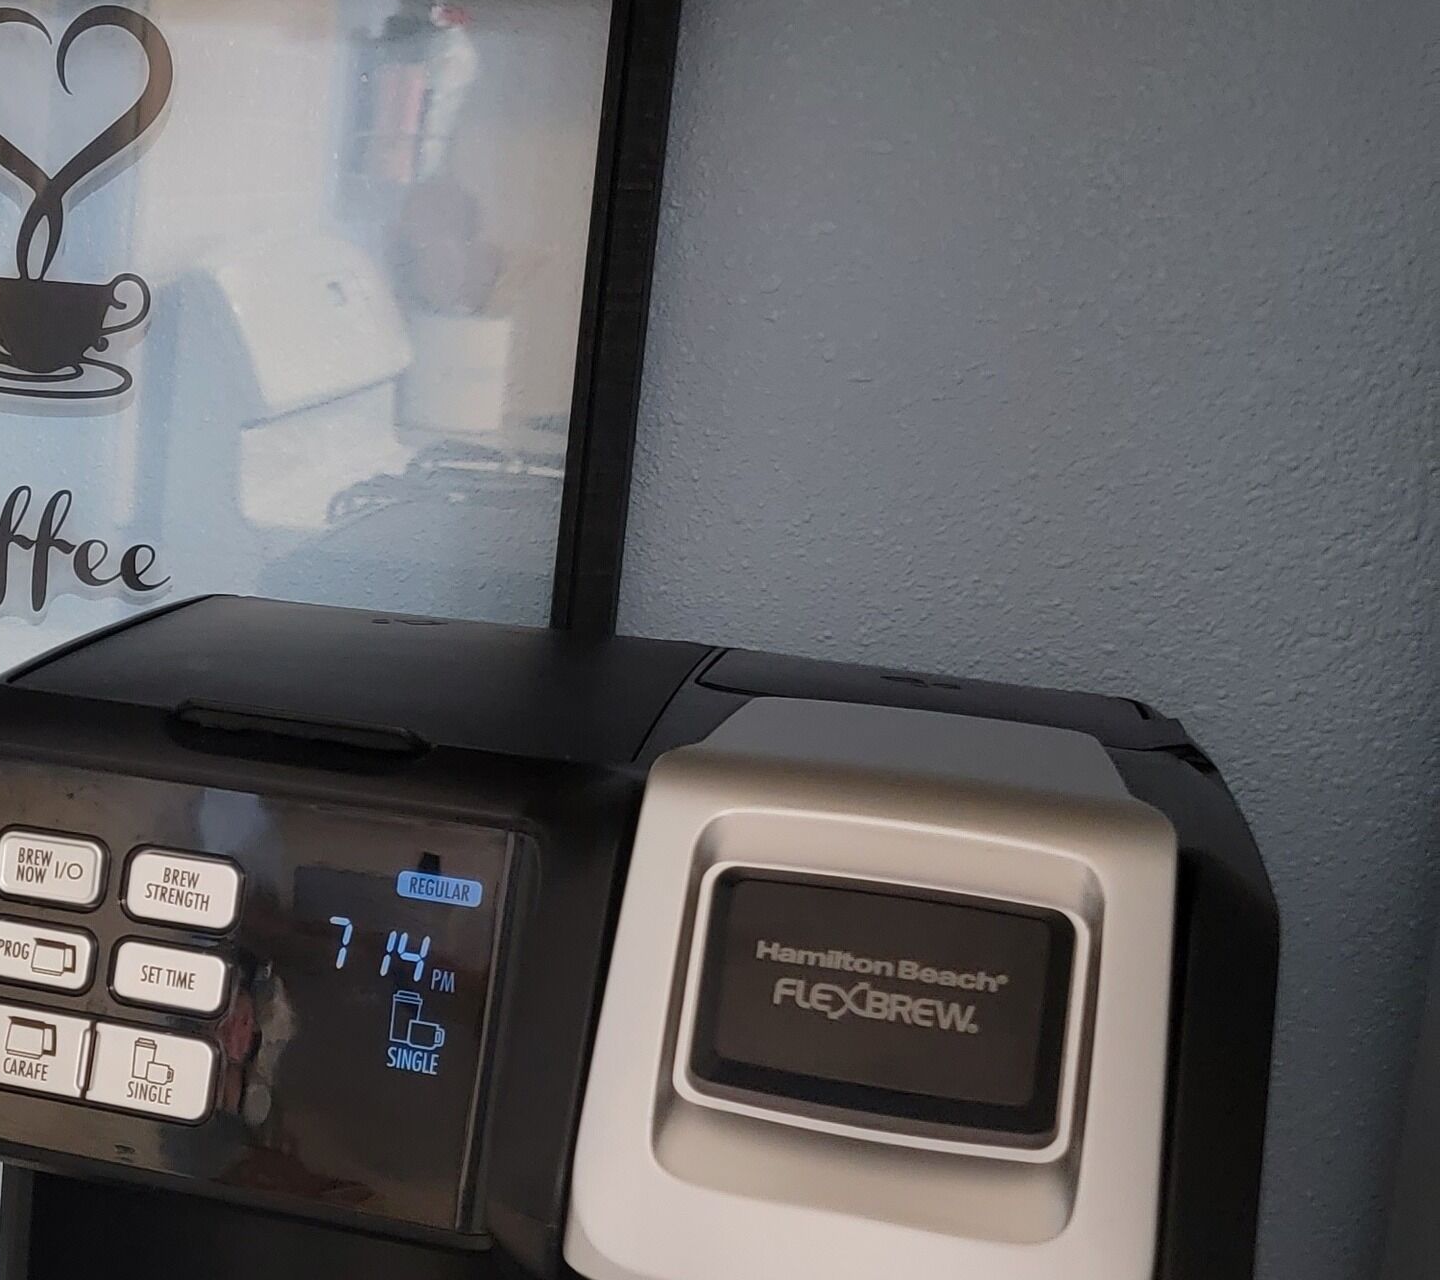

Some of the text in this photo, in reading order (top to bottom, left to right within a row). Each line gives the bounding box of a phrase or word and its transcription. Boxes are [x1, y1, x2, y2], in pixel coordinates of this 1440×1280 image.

[17, 847, 54, 867] BREW
[16, 865, 48, 884] NOW
[162, 867, 200, 889] BREW
[145, 883, 210, 912] STRENGTH
[409, 876, 471, 902] REGULAR
[755, 939, 896, 977] Hamilton
[140, 964, 196, 991] SET TIME
[431, 968, 456, 993] PM
[3, 1057, 49, 1082] CARAFE
[386, 1046, 440, 1076] SINGLE
[126, 1080, 173, 1106] SINGLE
